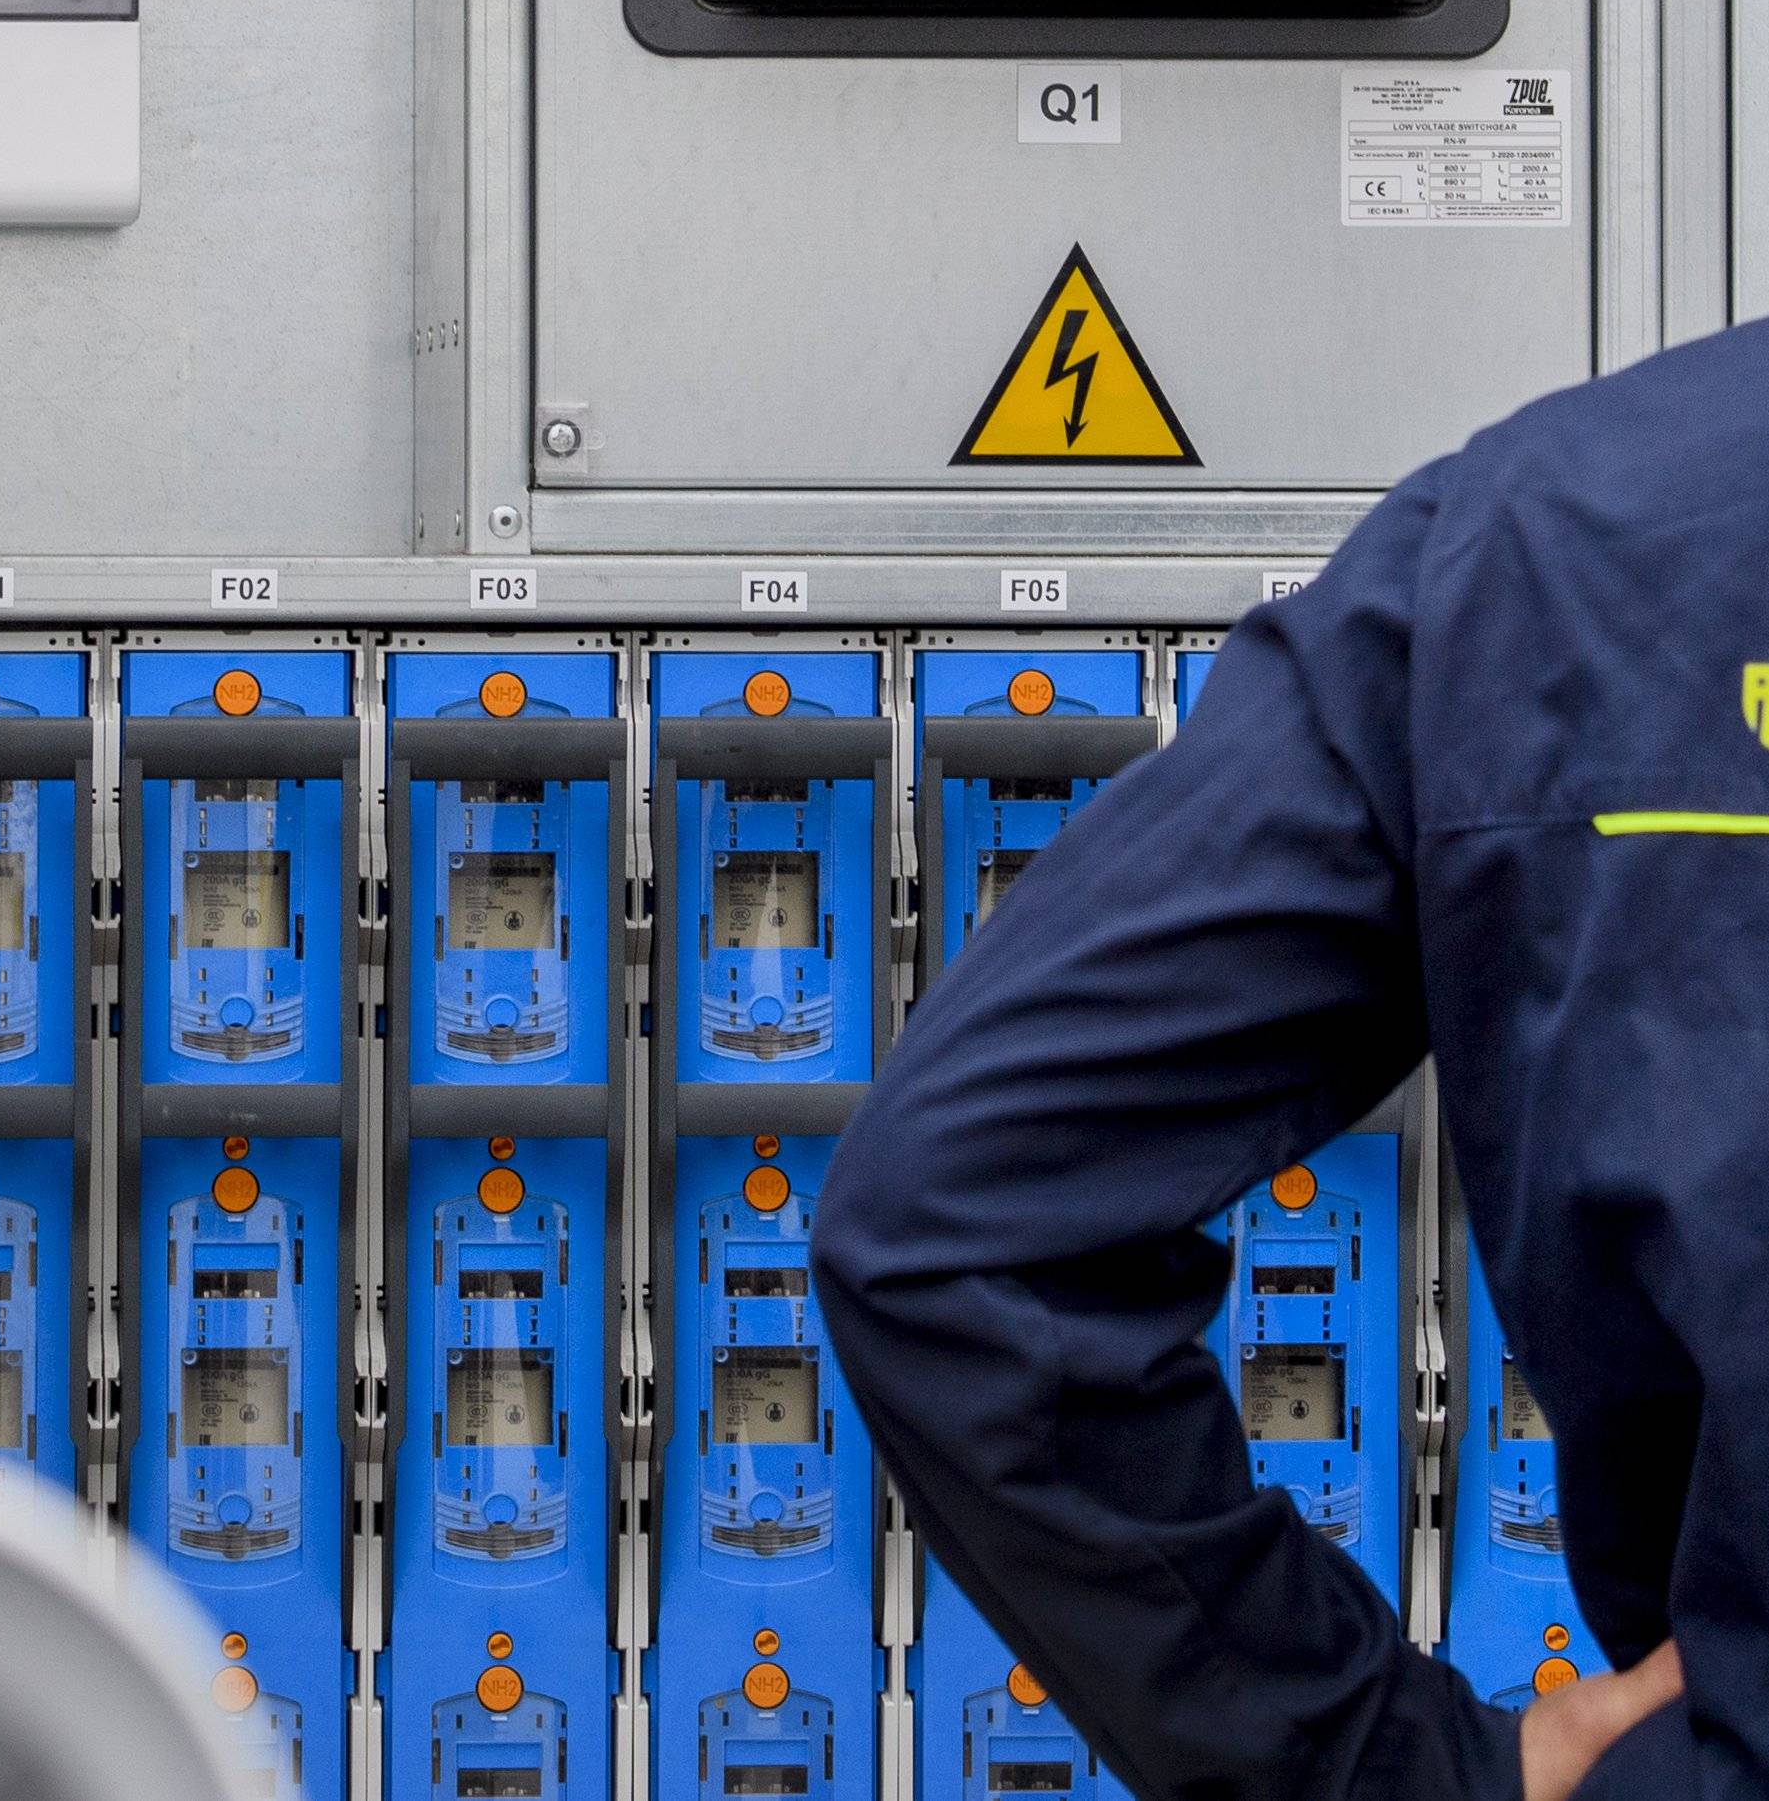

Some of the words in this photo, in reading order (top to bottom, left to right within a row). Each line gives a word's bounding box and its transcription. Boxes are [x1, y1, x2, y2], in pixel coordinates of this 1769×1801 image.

[1039, 82, 1101, 125] Q1
[1393, 123, 1414, 131] LOW
[1416, 123, 1456, 131] VOLTAGE
[1458, 123, 1518, 131] SWITCHGEAR
[221, 578, 271, 601] F02
[479, 578, 528, 602] F03
[749, 581, 800, 605] F04
[1011, 580, 1060, 604] F05
[1272, 581, 1304, 601] F0
[219, 684, 257, 703] NH2
[484, 684, 521, 704] NH2
[749, 684, 785, 703] NH2
[1013, 683, 1050, 703] NH2
